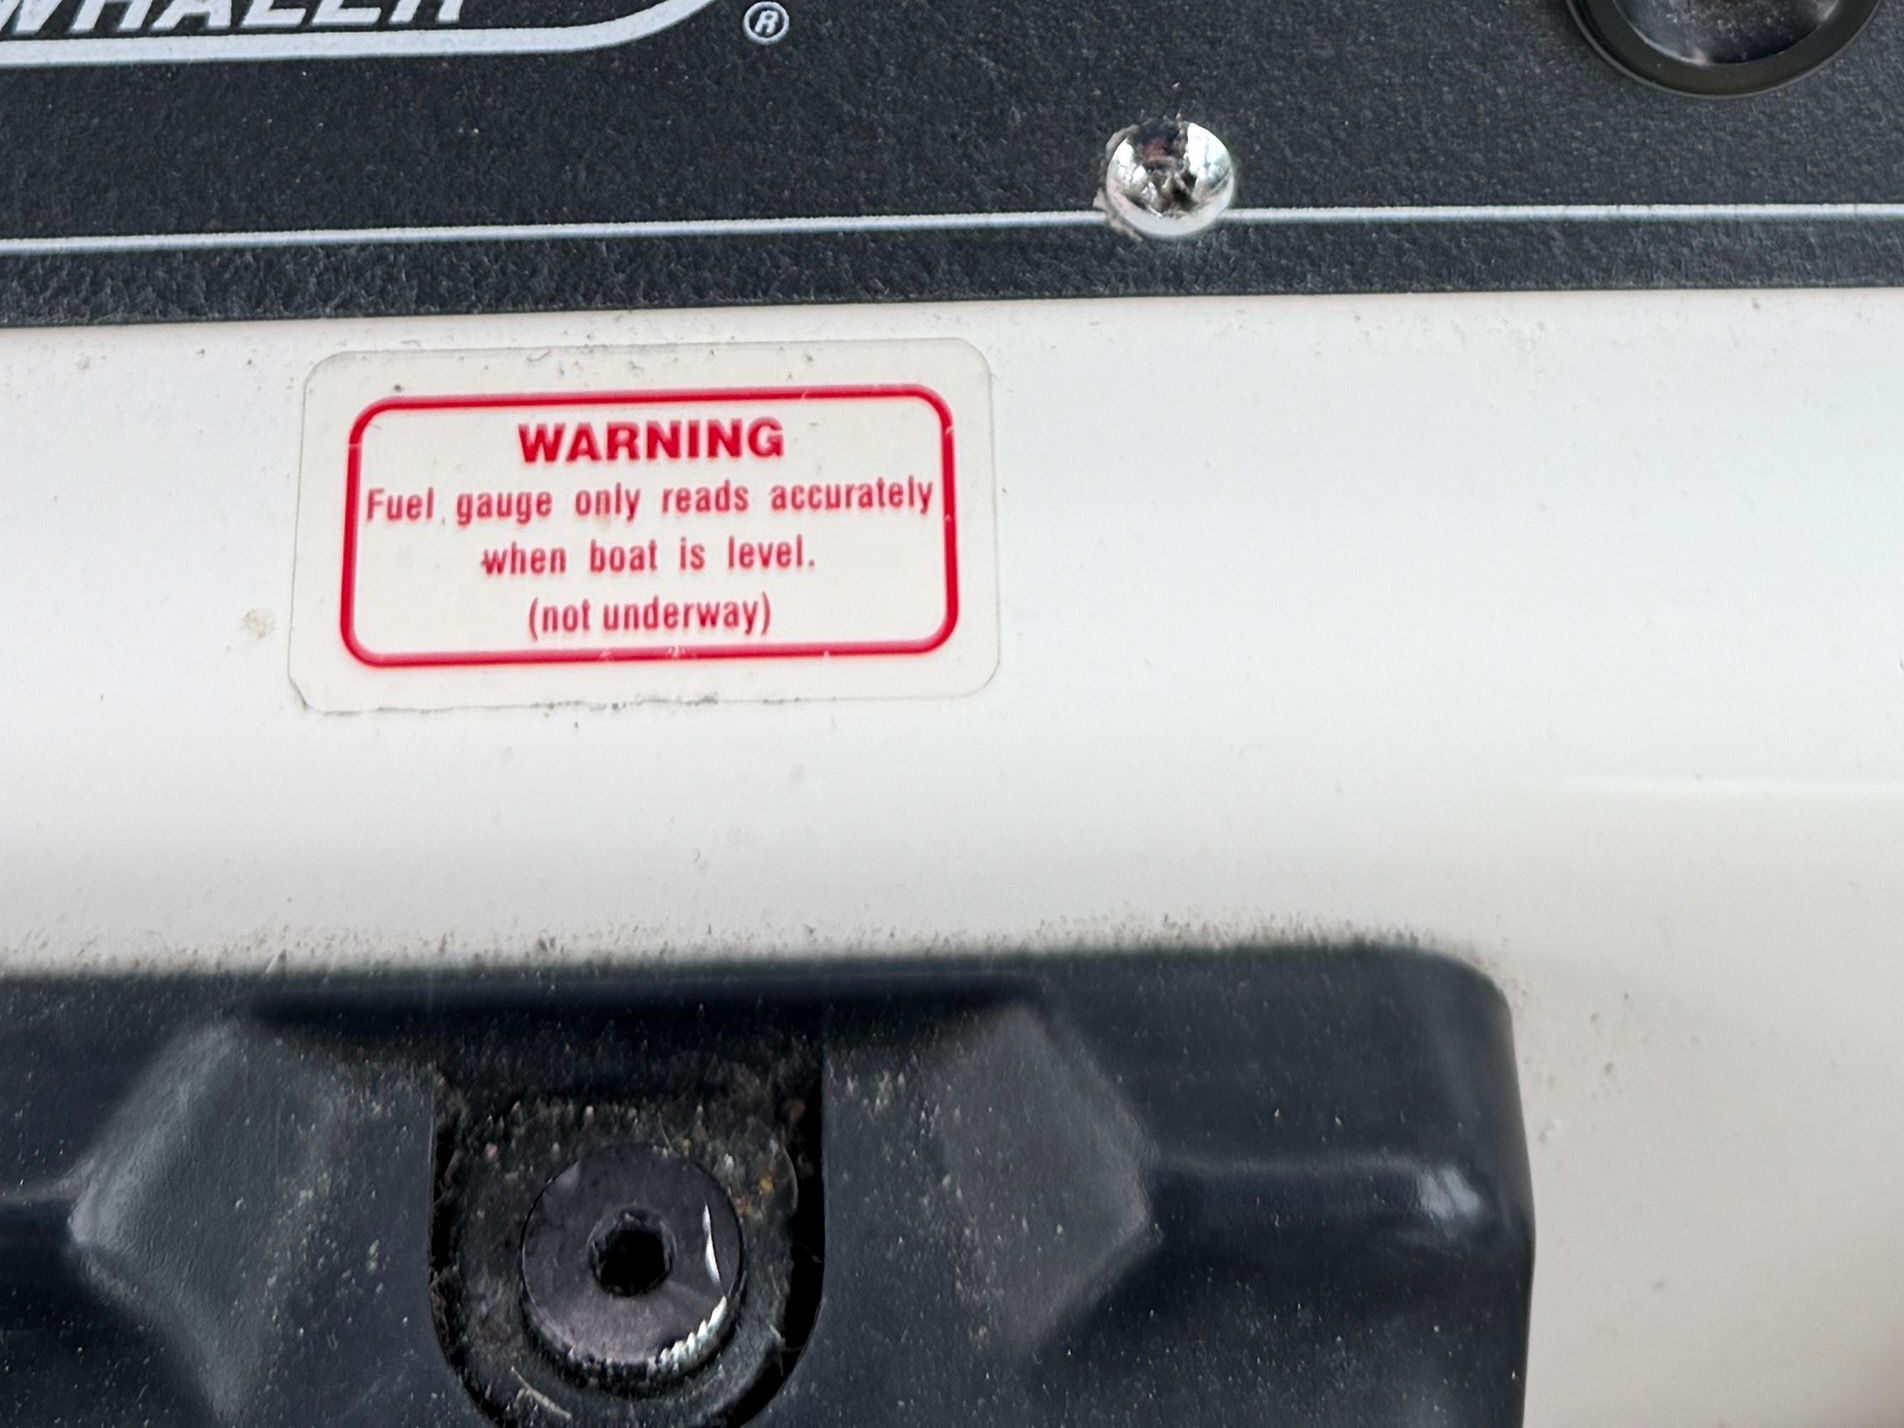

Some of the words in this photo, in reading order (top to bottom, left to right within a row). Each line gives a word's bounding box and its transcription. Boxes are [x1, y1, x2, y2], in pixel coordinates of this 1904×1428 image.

[519, 420, 782, 463] WARNING
[366, 489, 434, 522] Fuel
[456, 493, 552, 528] gauge
[575, 483, 640, 524] only
[662, 481, 748, 514] reads
[771, 477, 932, 516] accurately
[481, 543, 566, 576] when
[589, 541, 657, 573] boat
[680, 538, 705, 571] is
[728, 536, 816, 570] level.
[528, 600, 590, 641] (not
[603, 595, 771, 636] underway)
